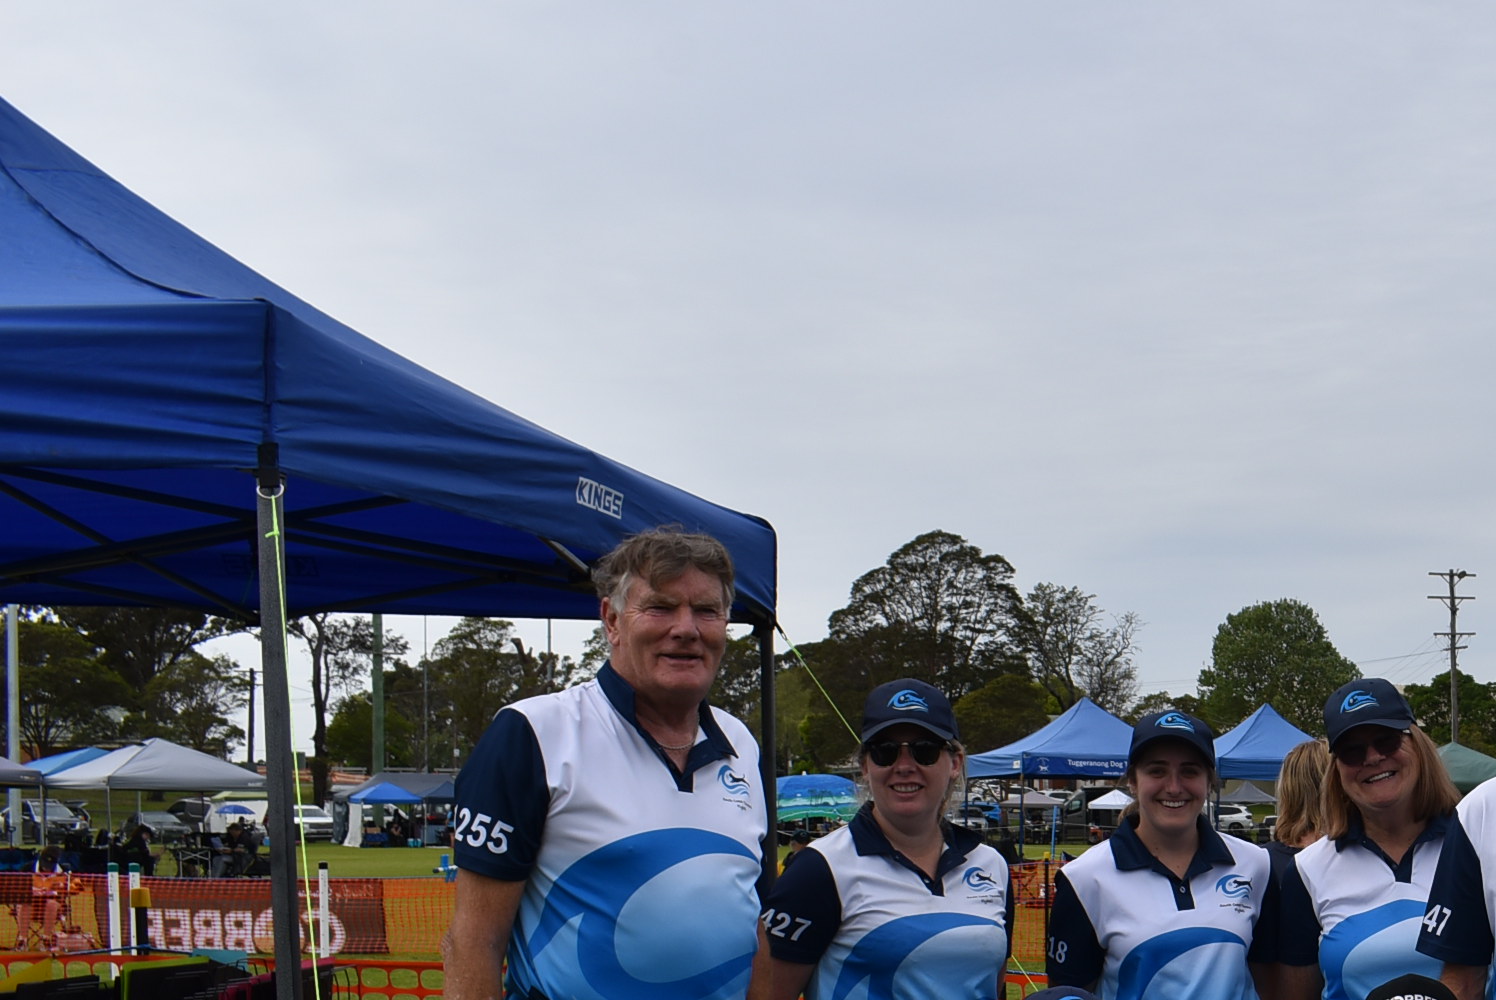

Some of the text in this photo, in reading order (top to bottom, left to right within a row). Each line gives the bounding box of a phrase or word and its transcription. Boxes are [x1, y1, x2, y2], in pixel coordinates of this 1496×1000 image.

[577, 478, 623, 518] KINGS
[1067, 758, 1110, 769] Tuggeranong
[1110, 760, 1124, 769] Dog
[453, 804, 515, 855] 255
[760, 908, 812, 942] 427
[1423, 904, 1452, 937] 47
[1048, 935, 1068, 964] 18
